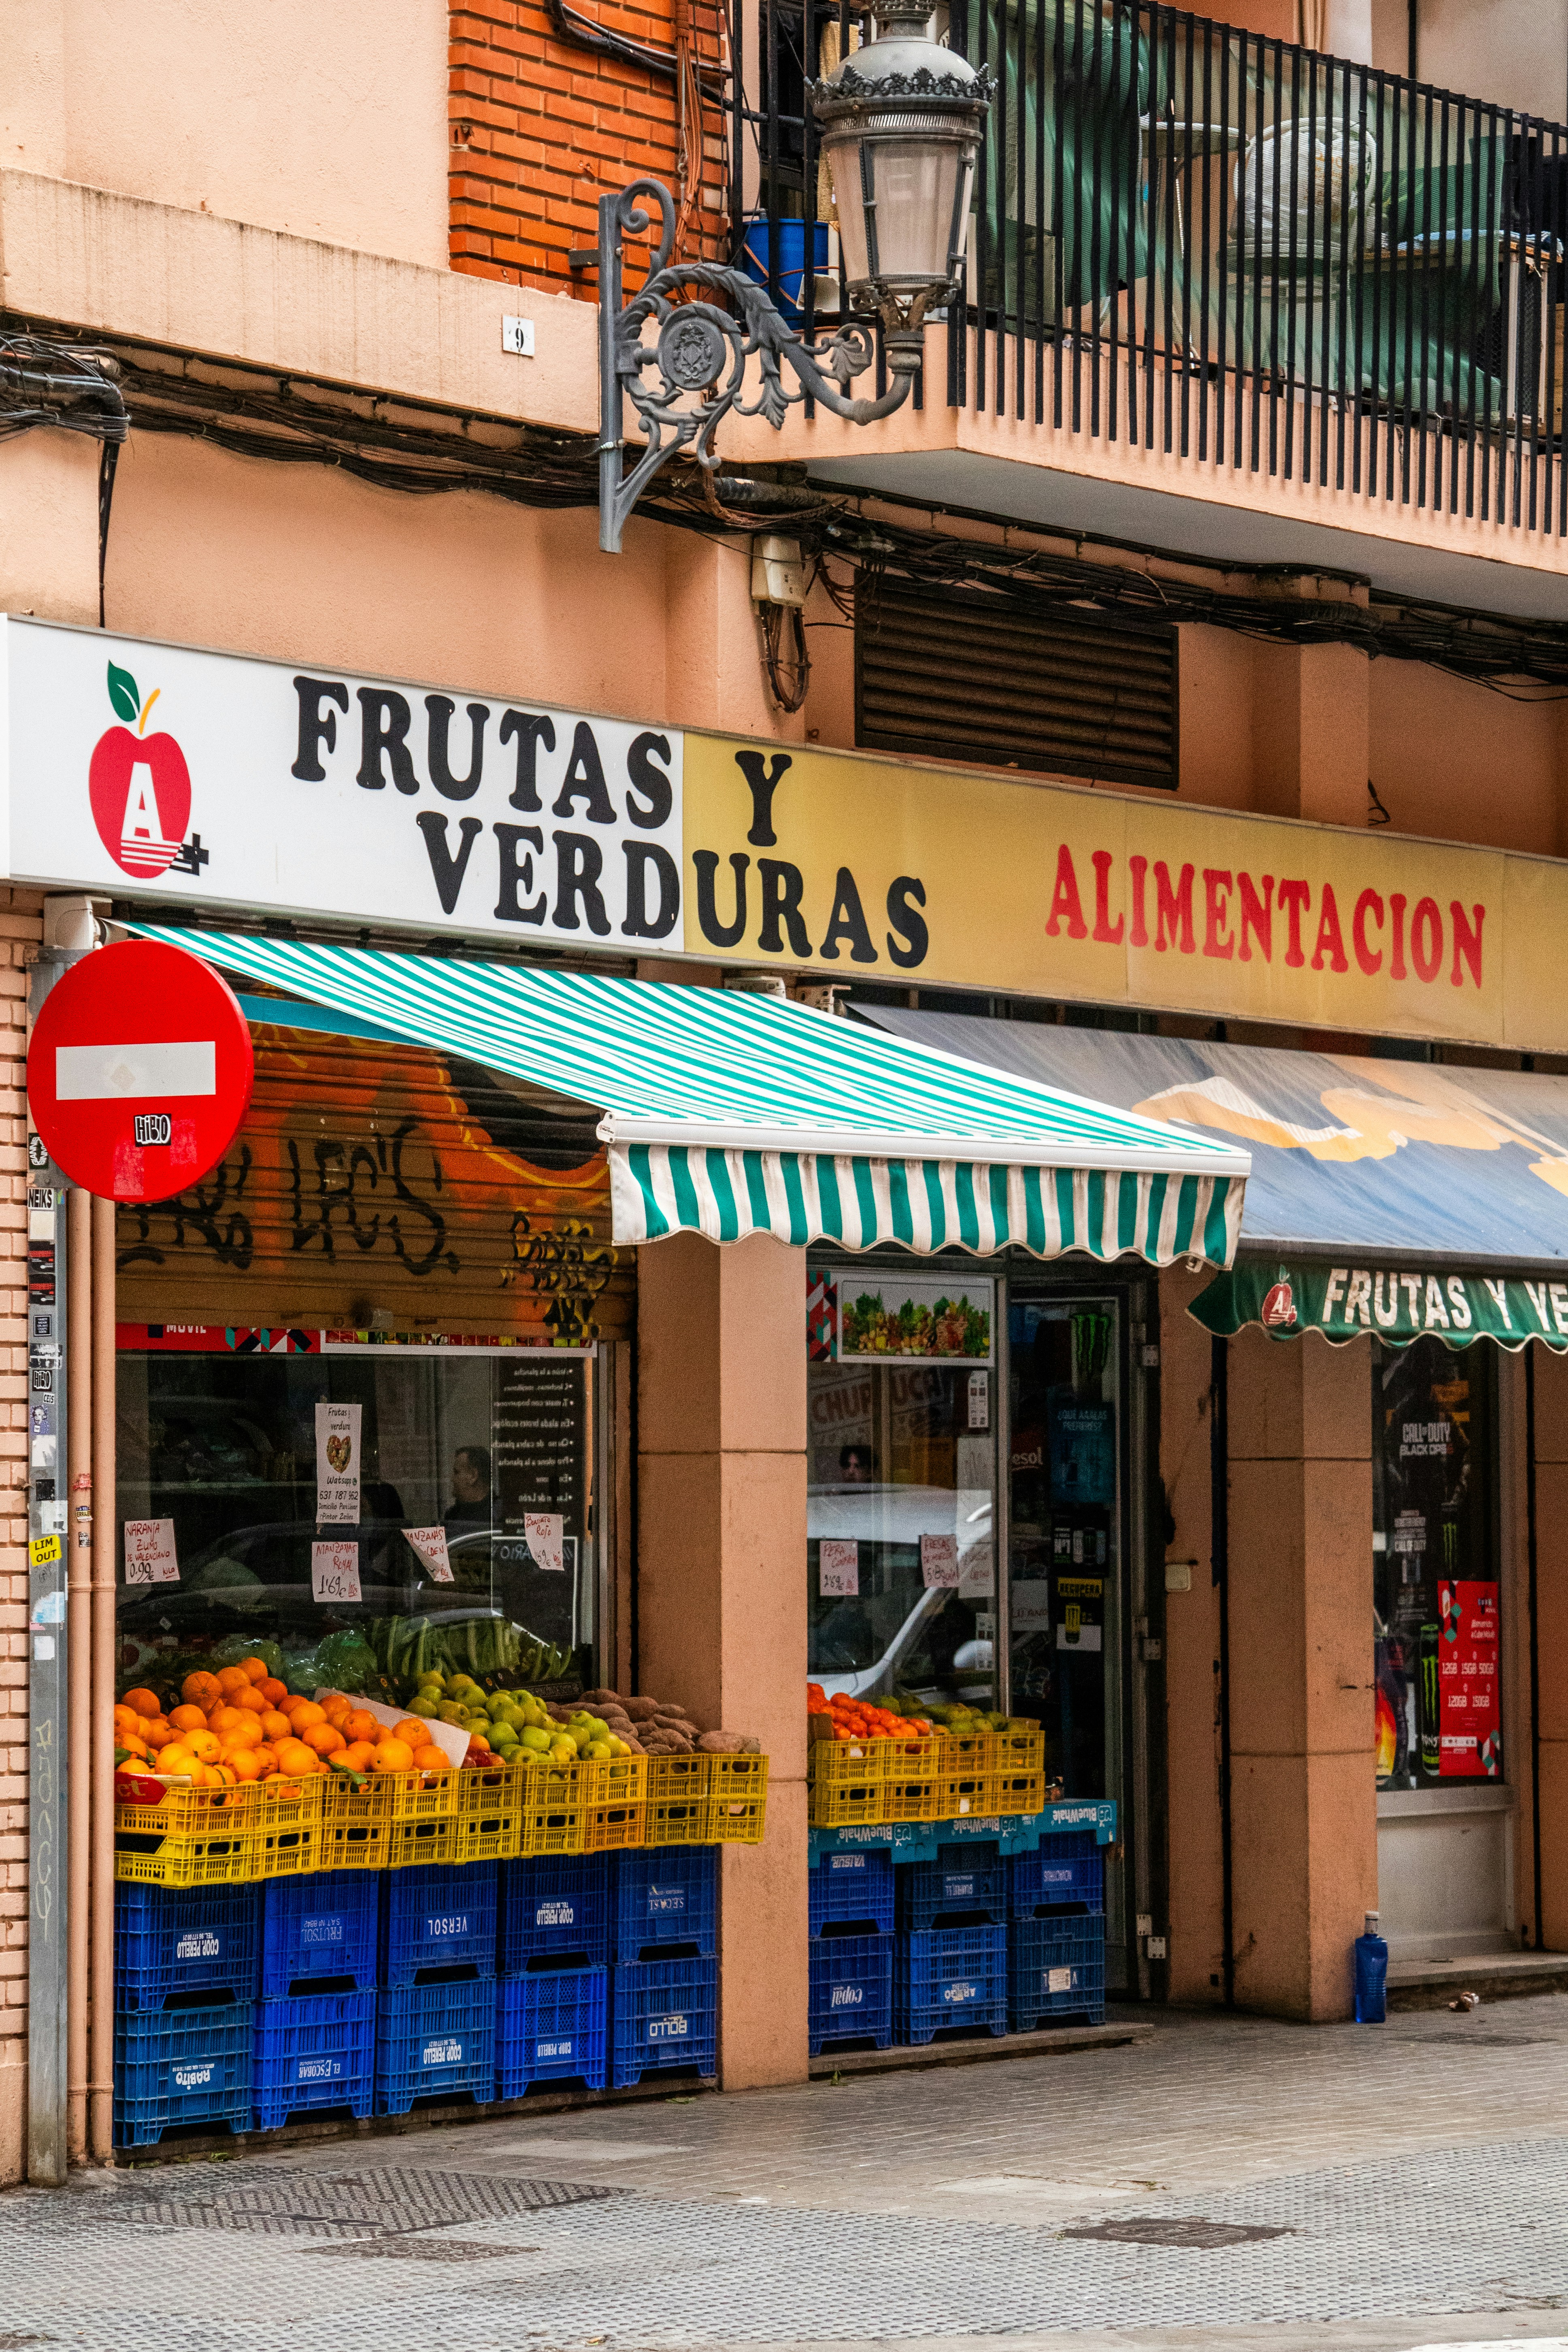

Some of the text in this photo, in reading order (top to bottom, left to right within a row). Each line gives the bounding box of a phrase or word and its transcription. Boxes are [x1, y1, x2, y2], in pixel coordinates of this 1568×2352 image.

[515, 328, 523, 349] 9
[291, 675, 792, 846] FRUTAS Y
[416, 811, 929, 968] VERDURAS
[1045, 844, 1485, 989] ALIMENTACION
[1322, 1268, 1472, 1329] FRUTAS
[1482, 1278, 1512, 1329] Y
[35, 1538, 53, 1550] LIM
[36, 1549, 57, 1562] OUT
[428, 1916, 467, 1936] VERSOL
[651, 2020, 687, 2037] BOLLO
